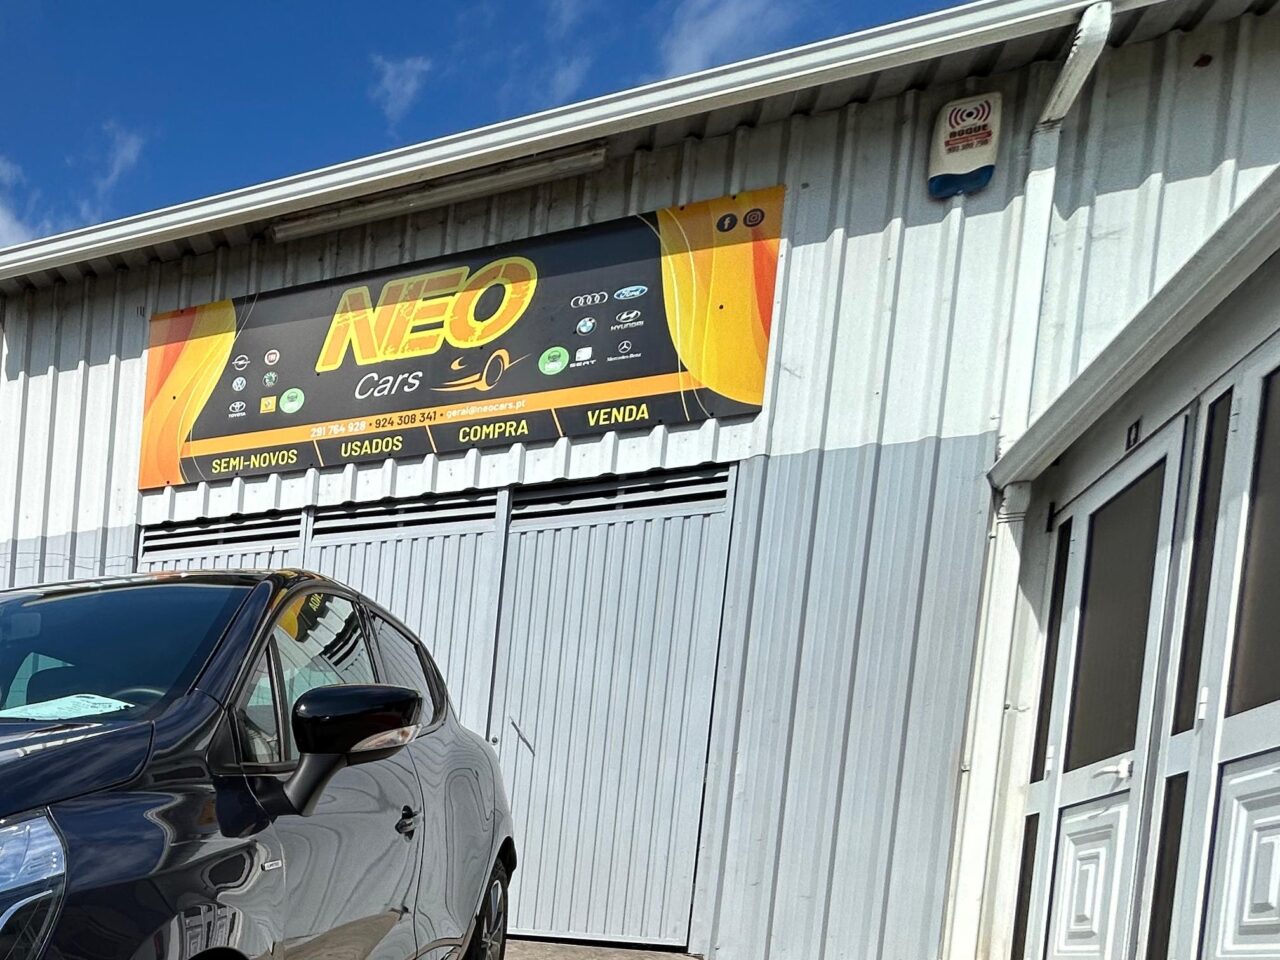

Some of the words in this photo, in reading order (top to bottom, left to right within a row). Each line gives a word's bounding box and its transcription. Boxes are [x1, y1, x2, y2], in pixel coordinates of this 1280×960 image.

[315, 256, 538, 373] NEO
[610, 321, 644, 331] HYUNDAI
[569, 359, 596, 368] SEAT
[354, 370, 424, 400] Cars
[347, 420, 366, 431] 928
[375, 415, 395, 429] 924
[397, 412, 417, 425] 308
[419, 410, 437, 423] 341
[446, 400, 526, 418] geral@neocars.pt
[587, 403, 650, 427] VENDA
[458, 419, 529, 443] COMPRA
[340, 436, 403, 457] USADOS
[211, 449, 298, 474] SEMI-NOVOS
